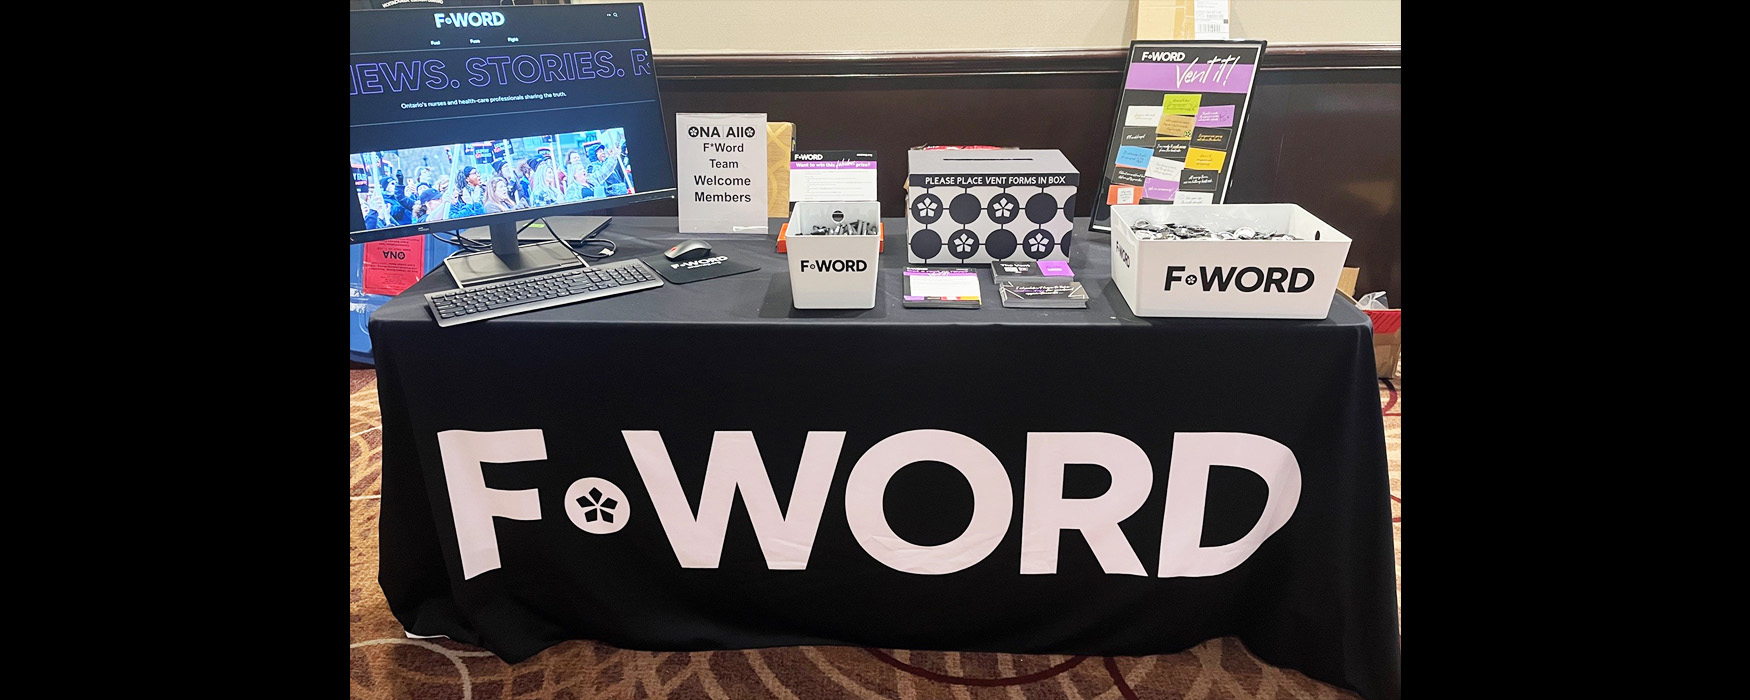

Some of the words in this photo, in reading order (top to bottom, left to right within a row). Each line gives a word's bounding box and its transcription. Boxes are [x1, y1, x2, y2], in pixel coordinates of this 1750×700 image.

[465, 50, 625, 88] STORIES.
[1176, 56, 1221, 89] Vent
[1212, 54, 1241, 86] it!
[401, 101, 428, 109] Ontario's
[459, 97, 490, 105] health-care
[490, 95, 525, 103] professionals
[524, 93, 544, 101] sharing
[688, 126, 721, 138] ONA
[709, 158, 739, 169] Team
[694, 175, 751, 186] Welcome
[925, 176, 955, 185] PLEASE
[956, 176, 983, 185] PLACE
[985, 176, 1007, 185] VENT
[1008, 176, 1037, 185] FORMS
[1038, 176, 1048, 184] IN
[1048, 175, 1066, 184] BOX
[694, 191, 752, 203] Members
